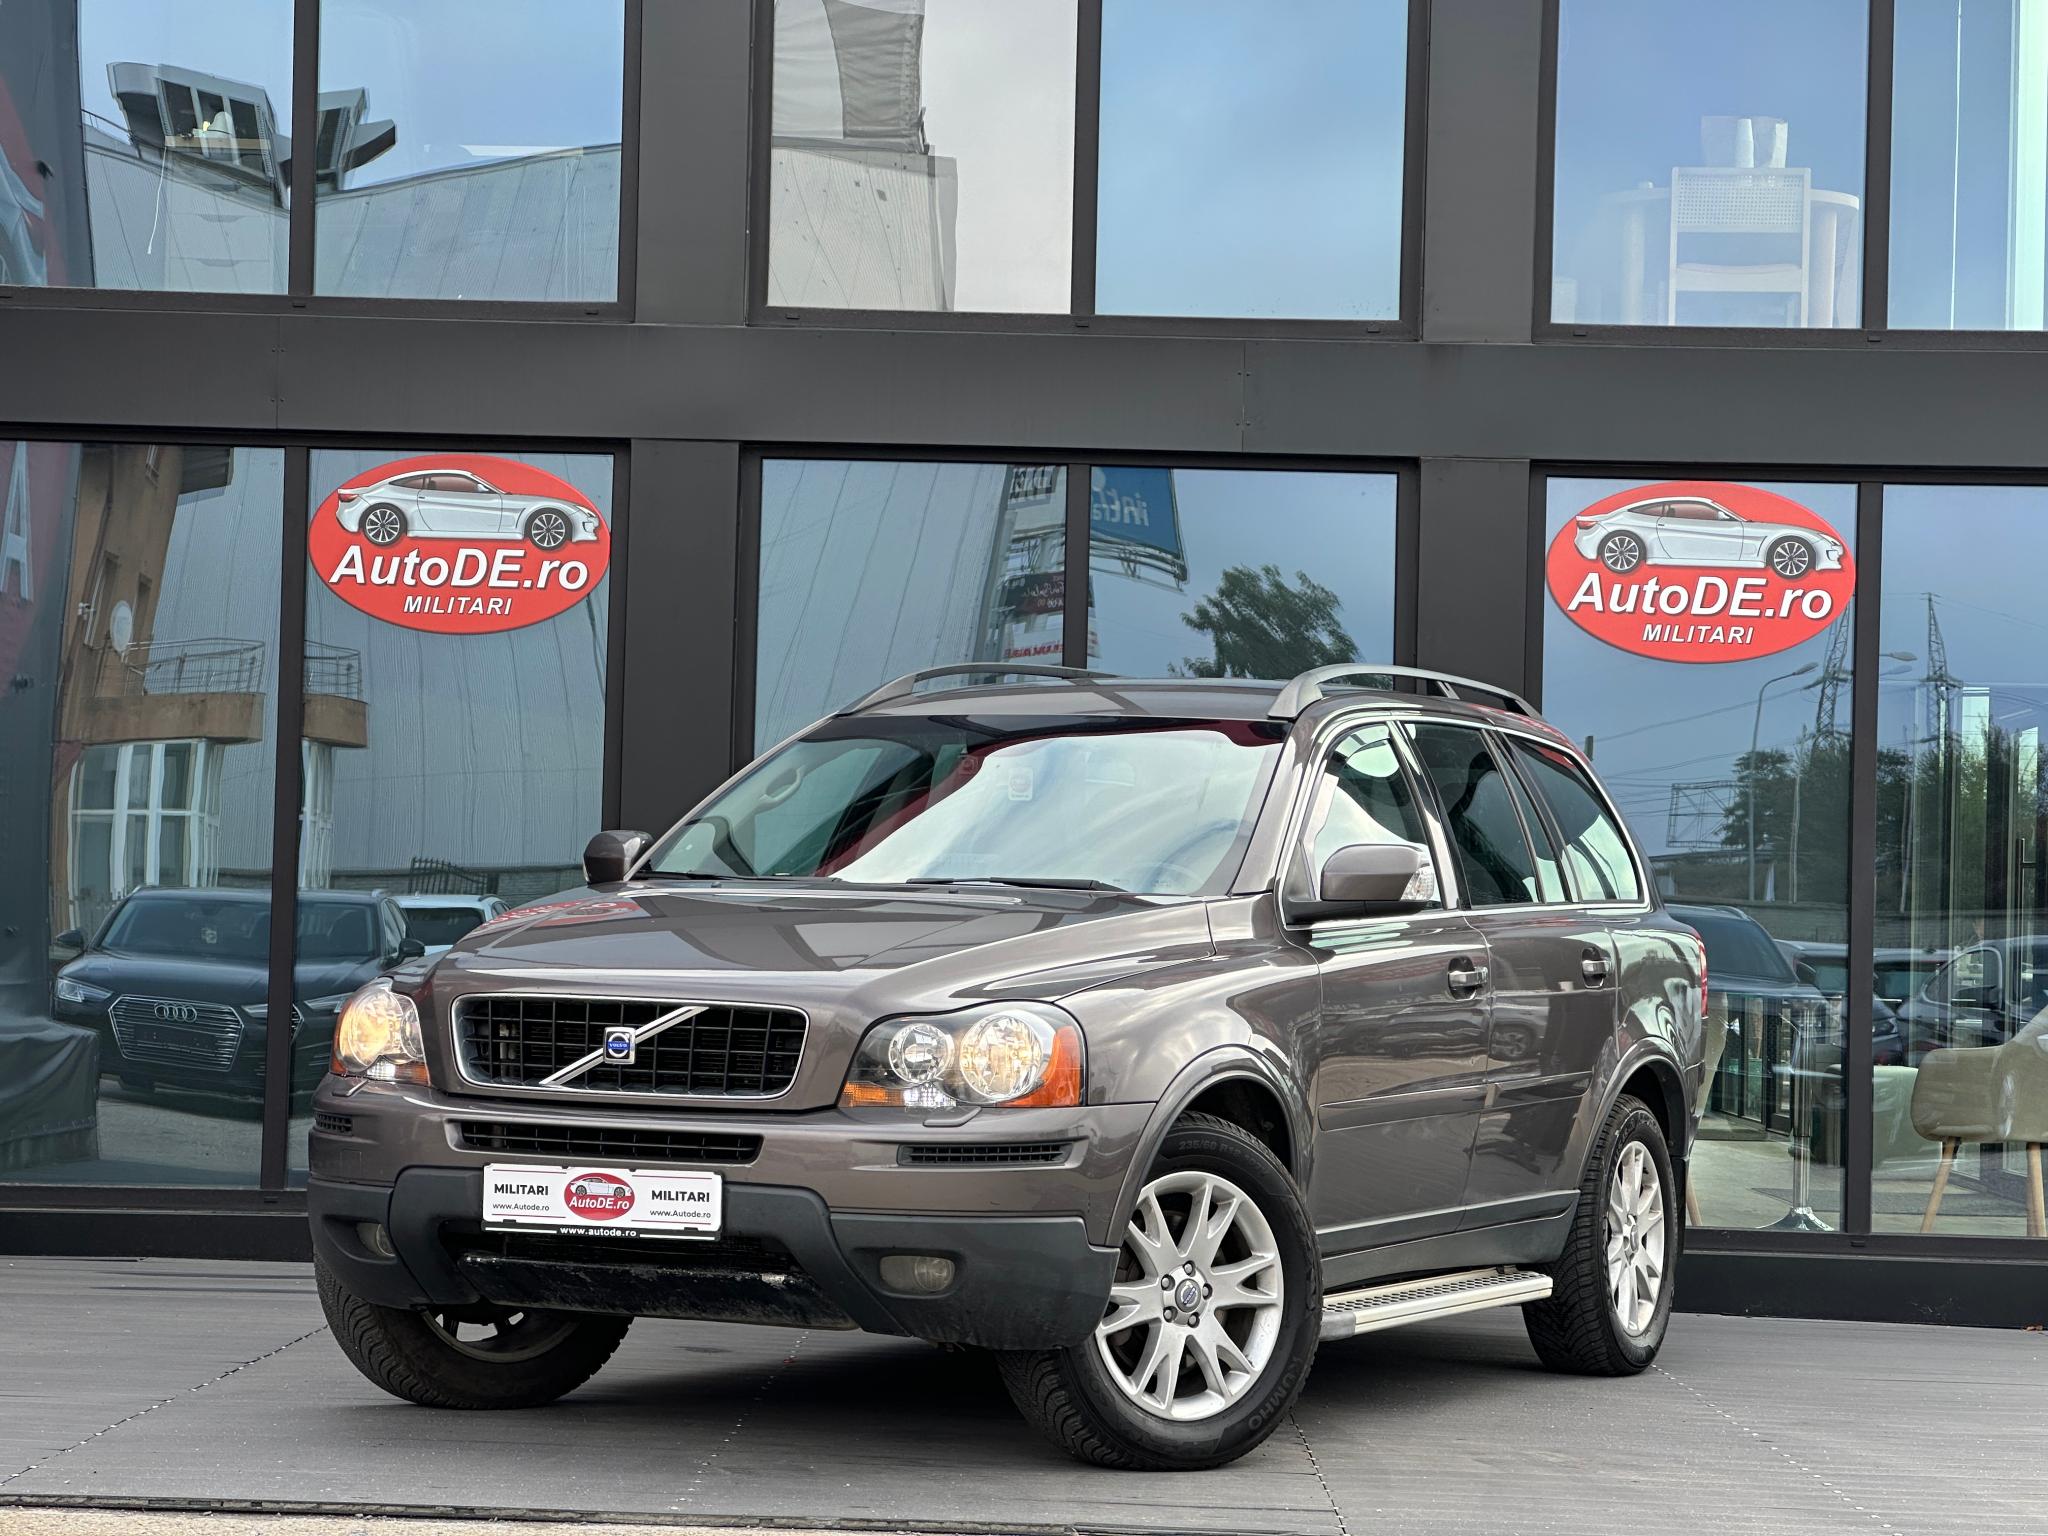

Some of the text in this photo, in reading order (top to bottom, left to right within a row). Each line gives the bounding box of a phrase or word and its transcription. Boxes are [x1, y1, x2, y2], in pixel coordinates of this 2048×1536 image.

[329, 545, 588, 591] AutoDE.ro
[1567, 572, 1833, 620] AutoDE.ro
[403, 595, 512, 616] MILITARI
[1642, 623, 1754, 644] MILITARI
[494, 1183, 549, 1196] MILITARI
[569, 1196, 630, 1210] AutoDE.ro
[651, 1190, 710, 1203] MILITARI
[492, 1202, 550, 1212] www.Autode.ro
[649, 1208, 711, 1219] www.Autode.ro
[559, 1226, 637, 1238] www.autode.ro
